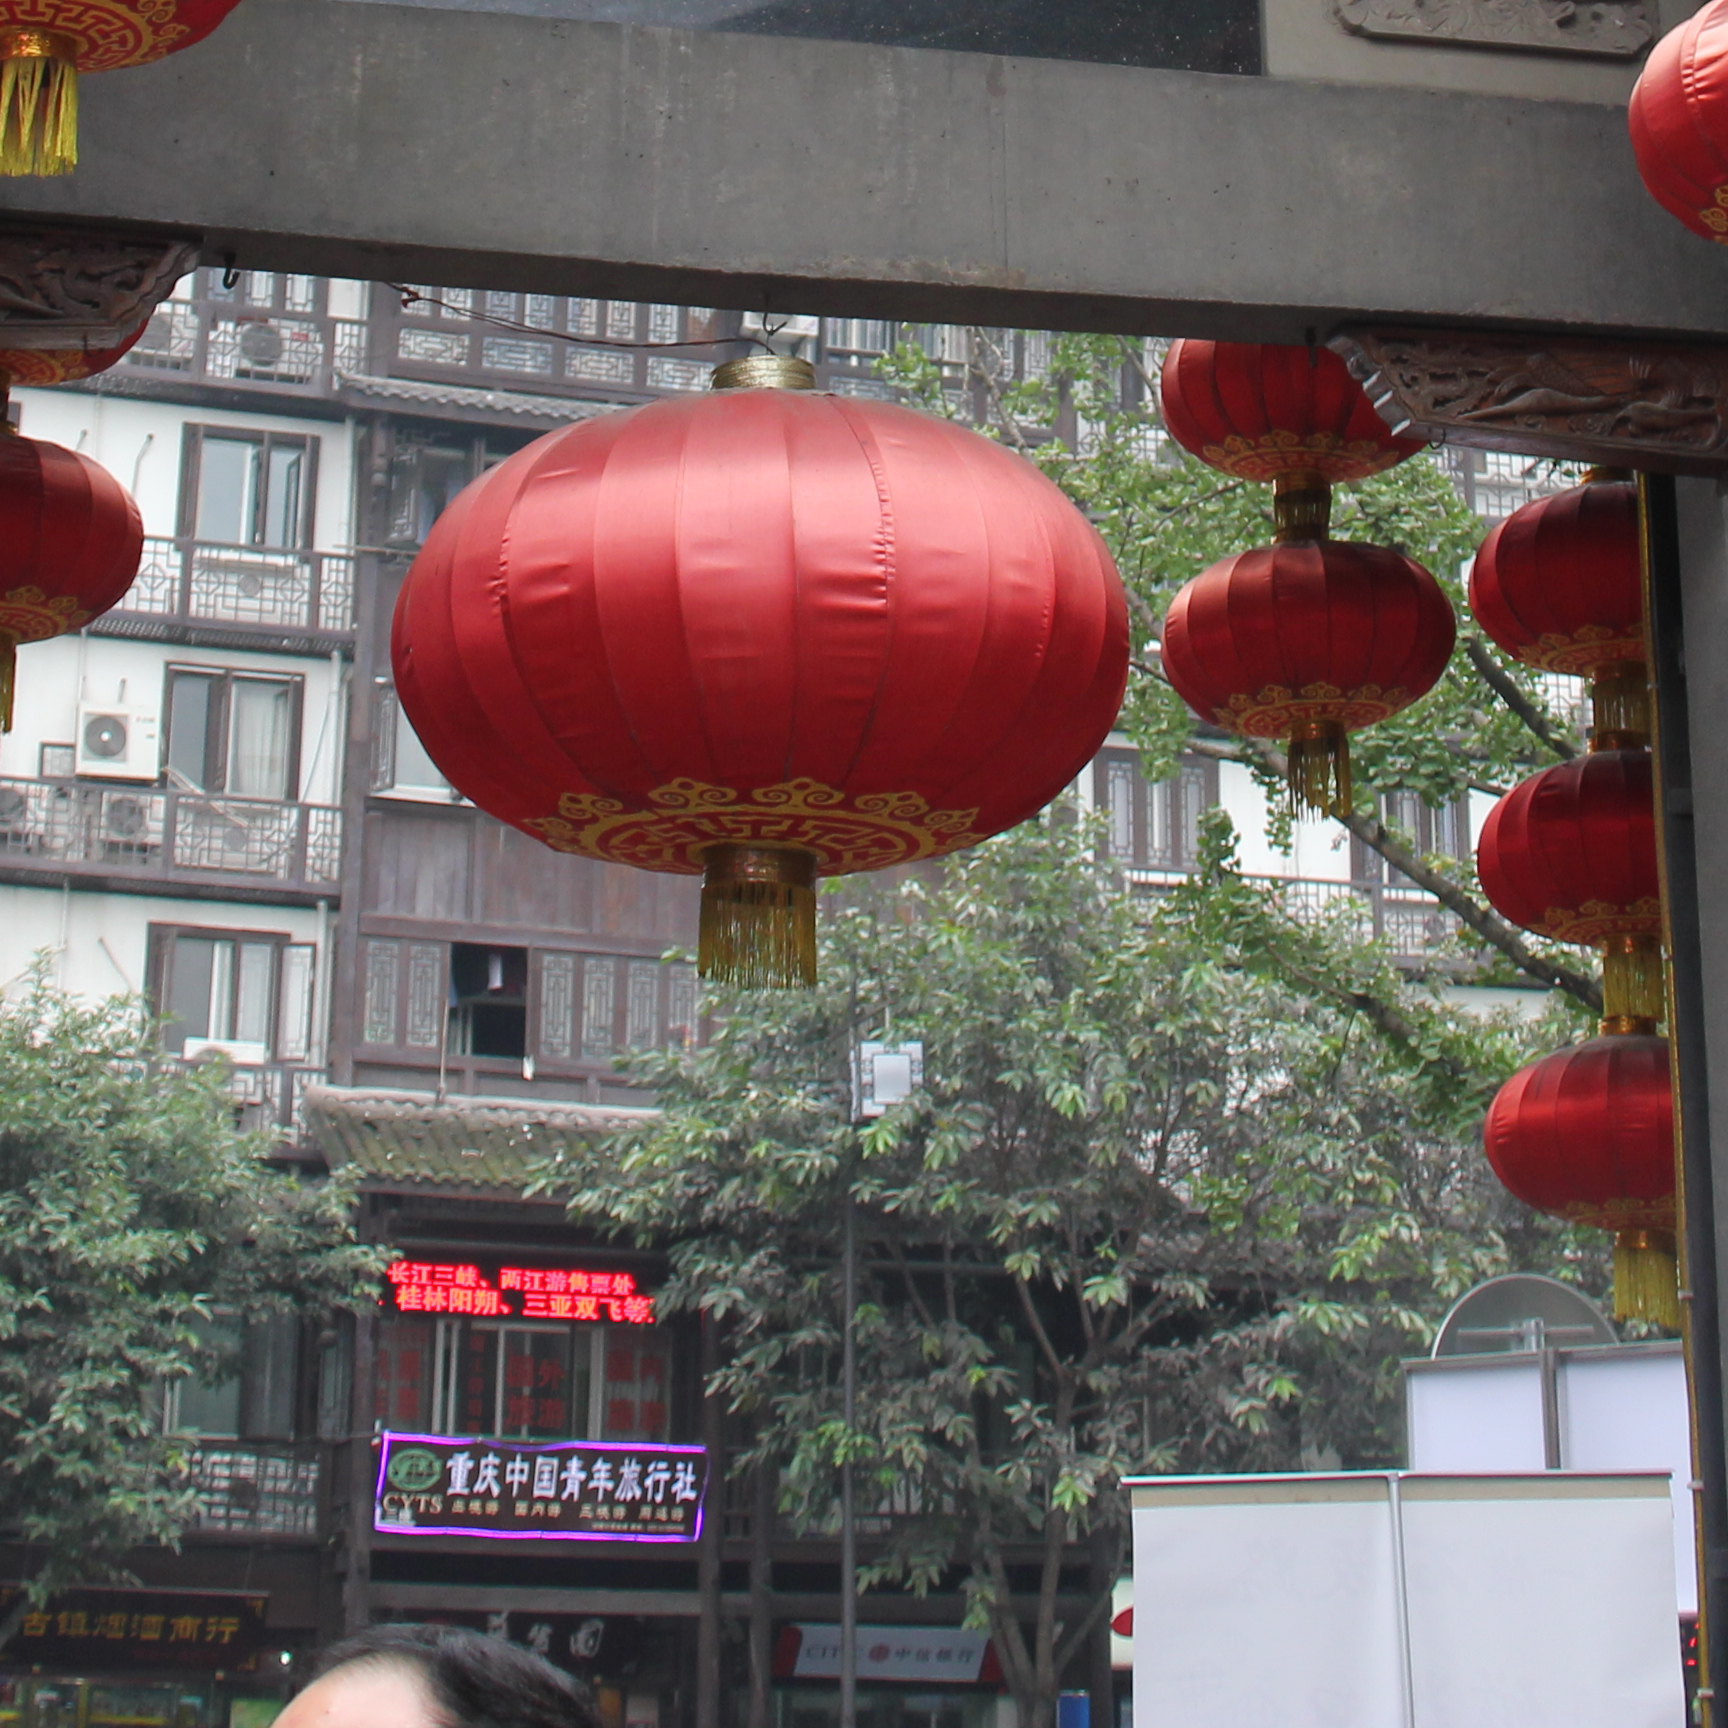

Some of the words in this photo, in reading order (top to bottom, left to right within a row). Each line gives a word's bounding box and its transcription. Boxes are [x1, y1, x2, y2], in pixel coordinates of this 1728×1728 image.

[446, 1451, 697, 1503] 重庆中国青年旅行社
[382, 1493, 443, 1515] CYTS
